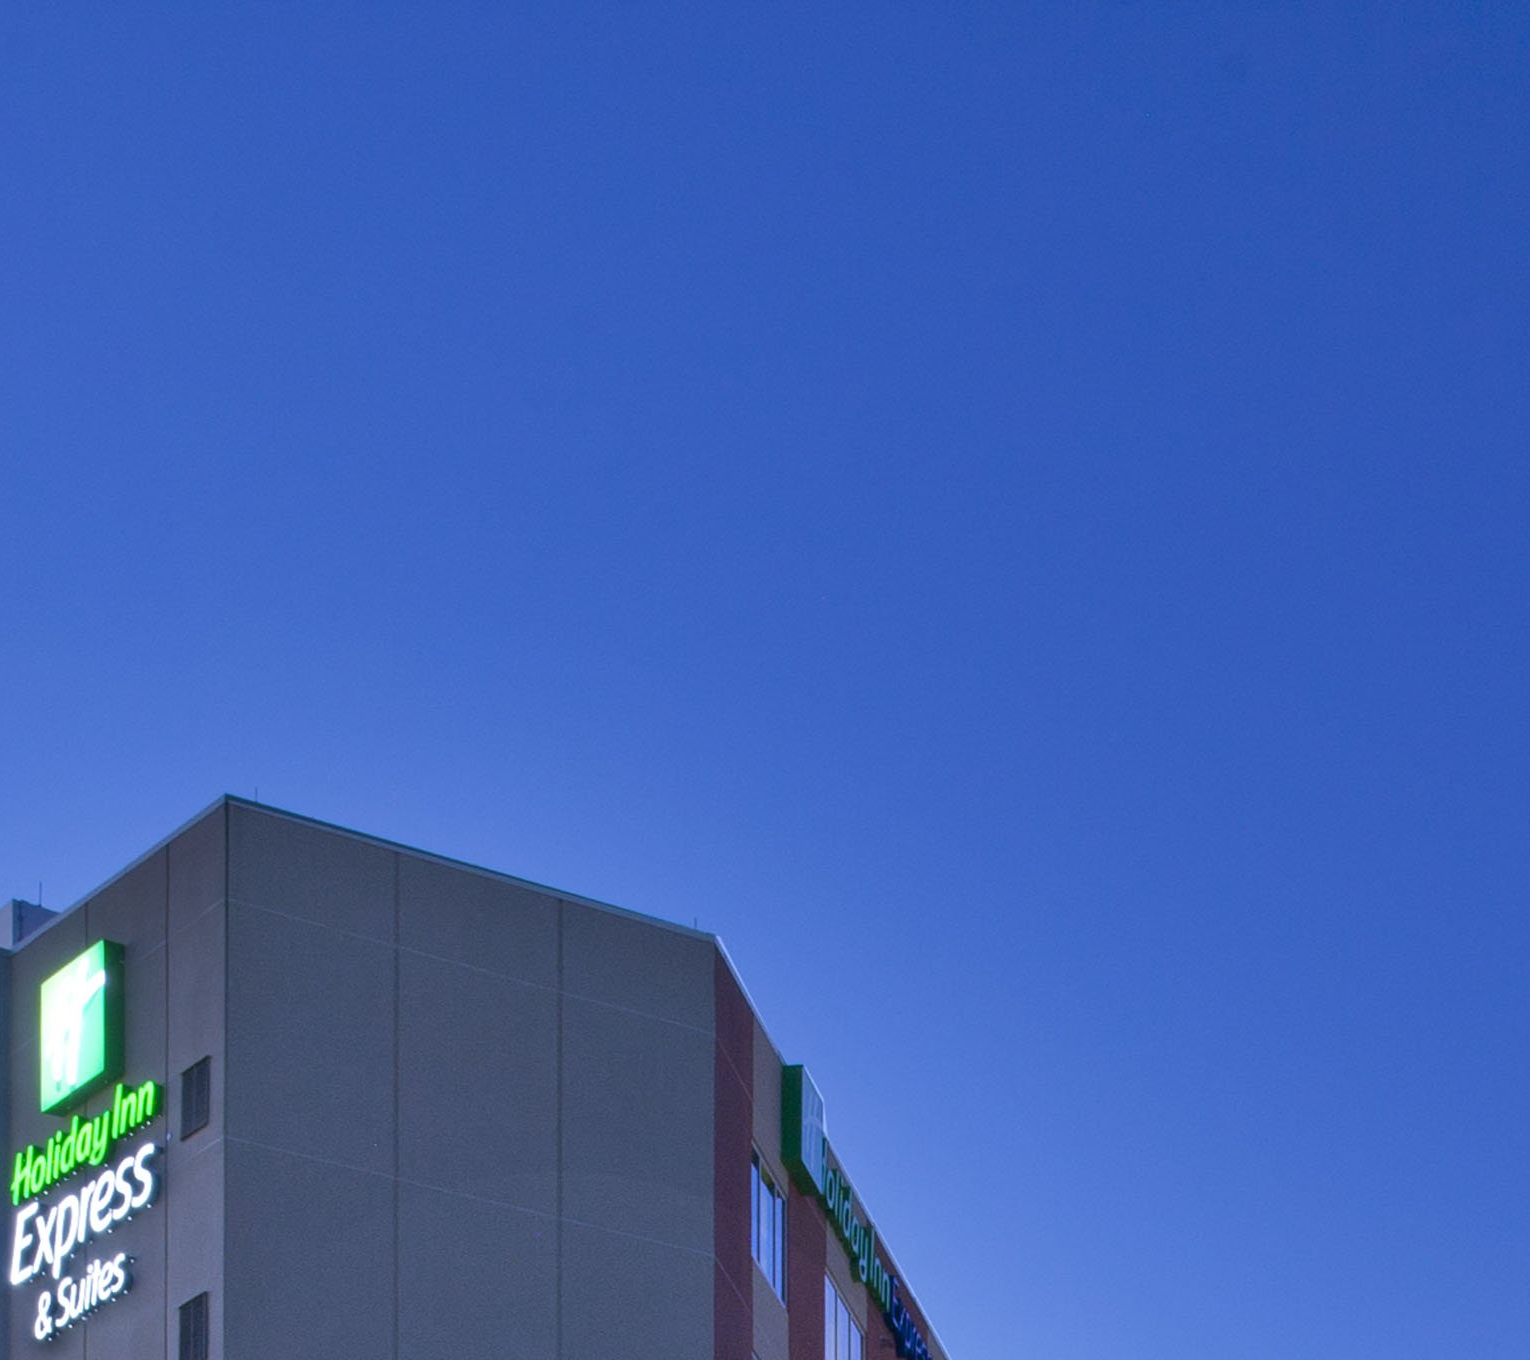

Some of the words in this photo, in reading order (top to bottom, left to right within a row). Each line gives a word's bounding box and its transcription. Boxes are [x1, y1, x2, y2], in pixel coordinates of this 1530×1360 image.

[10, 1110, 110, 1206] Holiday
[112, 1080, 157, 1140] Inn
[10, 1142, 156, 1287] Express
[34, 1291, 55, 1342] &
[55, 1252, 127, 1329] Suites
[870, 1227, 890, 1313] Inn
